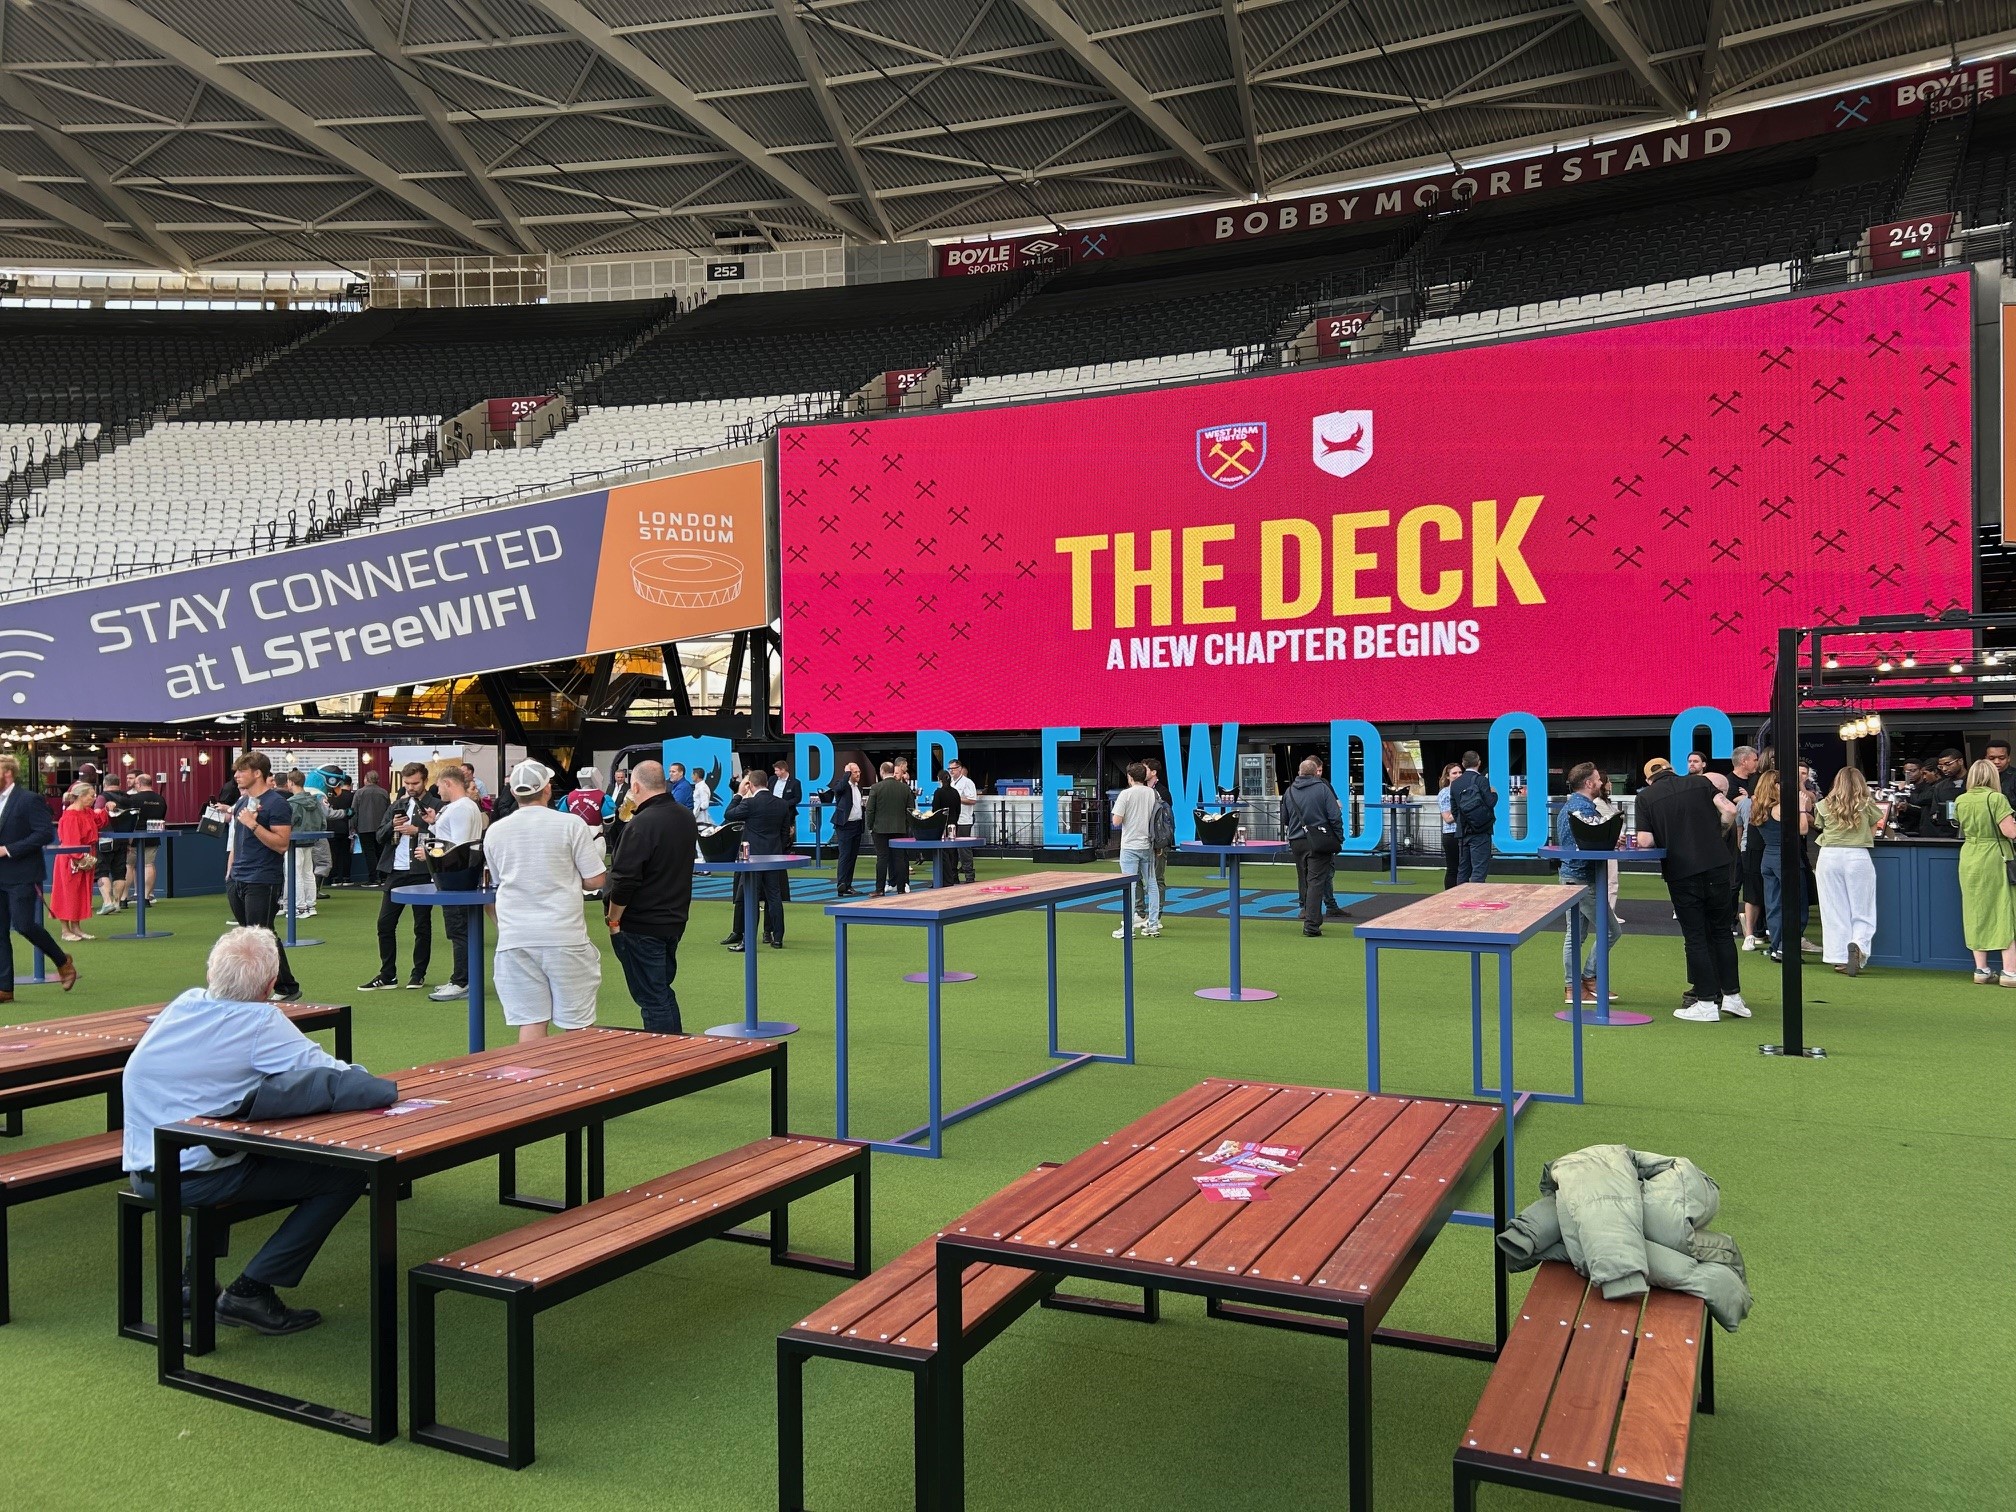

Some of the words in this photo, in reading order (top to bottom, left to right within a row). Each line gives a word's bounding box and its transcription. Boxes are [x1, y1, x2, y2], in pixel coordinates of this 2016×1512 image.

[1897, 67, 1994, 107] BOYLE
[1215, 196, 1360, 239] BOBBY
[1374, 163, 1543, 215] MOORE
[1561, 127, 1732, 182] STAND
[1889, 222, 1933, 247] 249
[948, 245, 1010, 266] BOYLE
[714, 266, 737, 277] 252
[967, 262, 1009, 275] SPORTS
[353, 285, 369, 295] 25
[1204, 428, 1232, 439] WEST
[1233, 426, 1258, 436] HAM
[1215, 434, 1247, 442] UNITED
[638, 510, 733, 528] LONDON
[639, 527, 734, 543] STADIUM
[1055, 523, 1237, 631] THE
[1260, 495, 1547, 621] DECK
[89, 587, 231, 654] STAY
[248, 524, 564, 621] CONNECTED
[165, 652, 225, 699] at
[231, 583, 537, 685] LSFreeWIFI
[1106, 638, 1125, 671] A
[1130, 634, 1198, 669] NEW
[1204, 626, 1346, 666] CHAPTER
[1353, 619, 1481, 660] BEGINS
